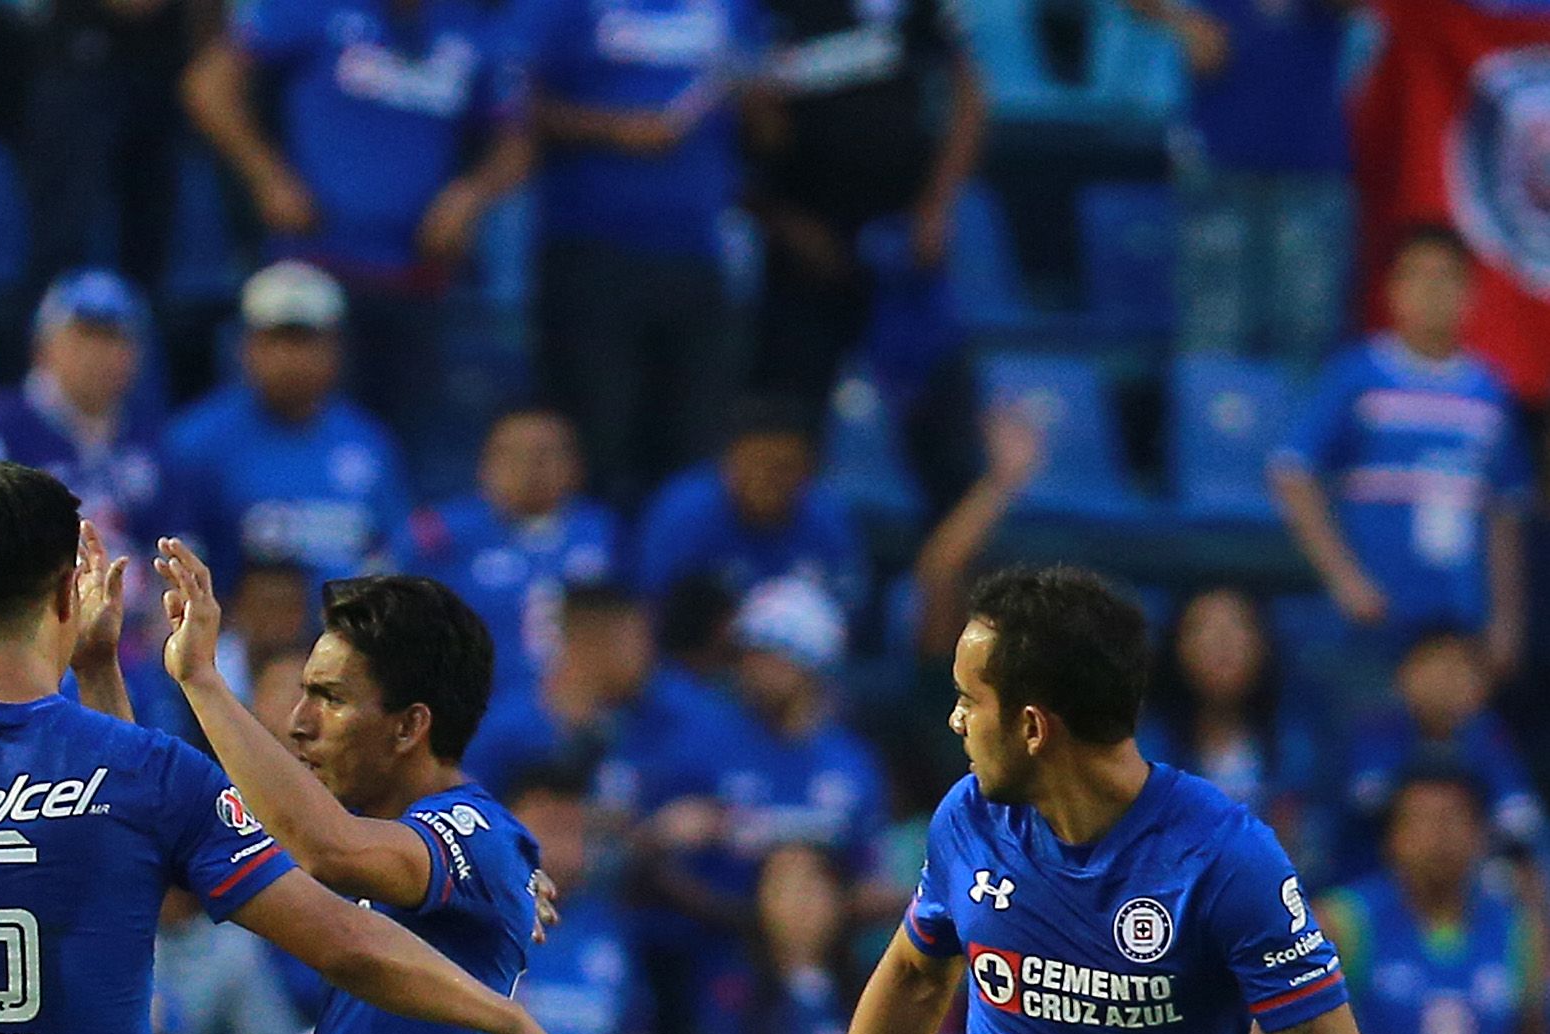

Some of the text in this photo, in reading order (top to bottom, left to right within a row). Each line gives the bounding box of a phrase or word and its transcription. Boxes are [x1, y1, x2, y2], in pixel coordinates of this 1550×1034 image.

[1021, 956, 1172, 1001] CEMENTO
[1022, 990, 1183, 1028] CRUZ AZUL
